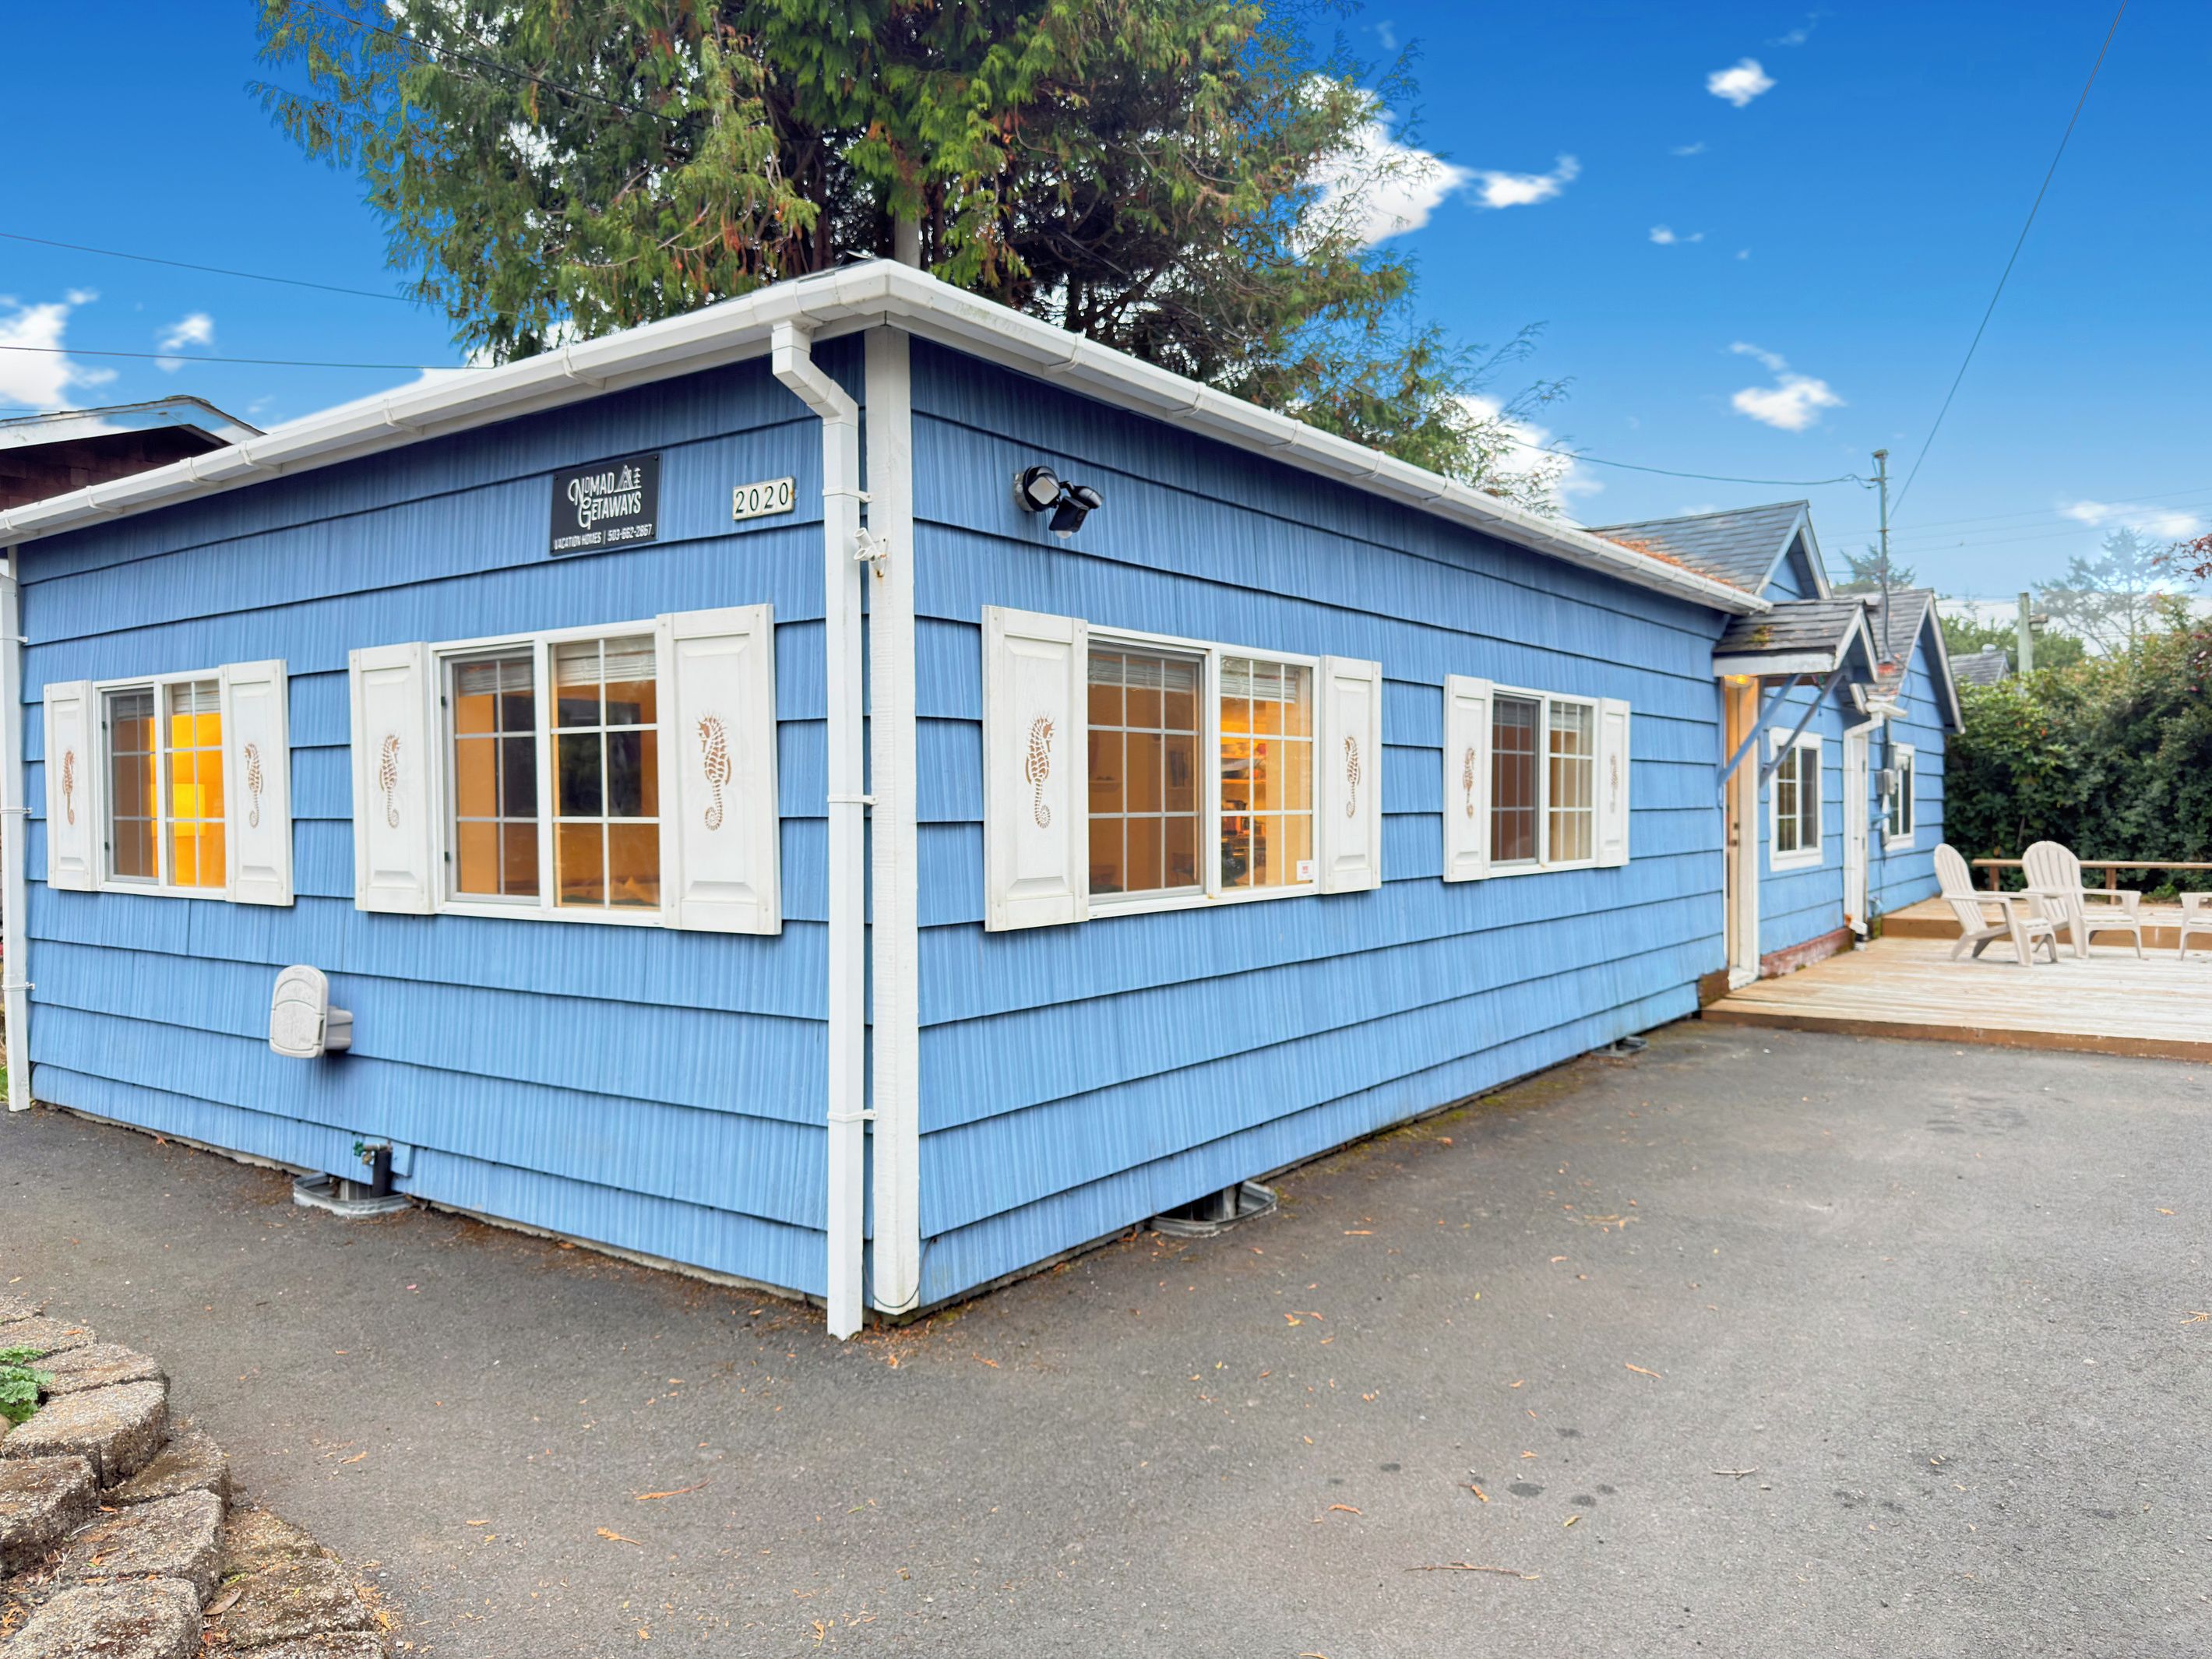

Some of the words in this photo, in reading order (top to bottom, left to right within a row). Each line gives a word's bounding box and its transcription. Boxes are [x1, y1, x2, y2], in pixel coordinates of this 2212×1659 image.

[568, 473, 615, 505] NOMAD
[735, 482, 789, 515] 2020
[579, 491, 641, 530] GETAWAYS
[554, 536, 580, 550] VACATION
[582, 532, 601, 546] HOMES
